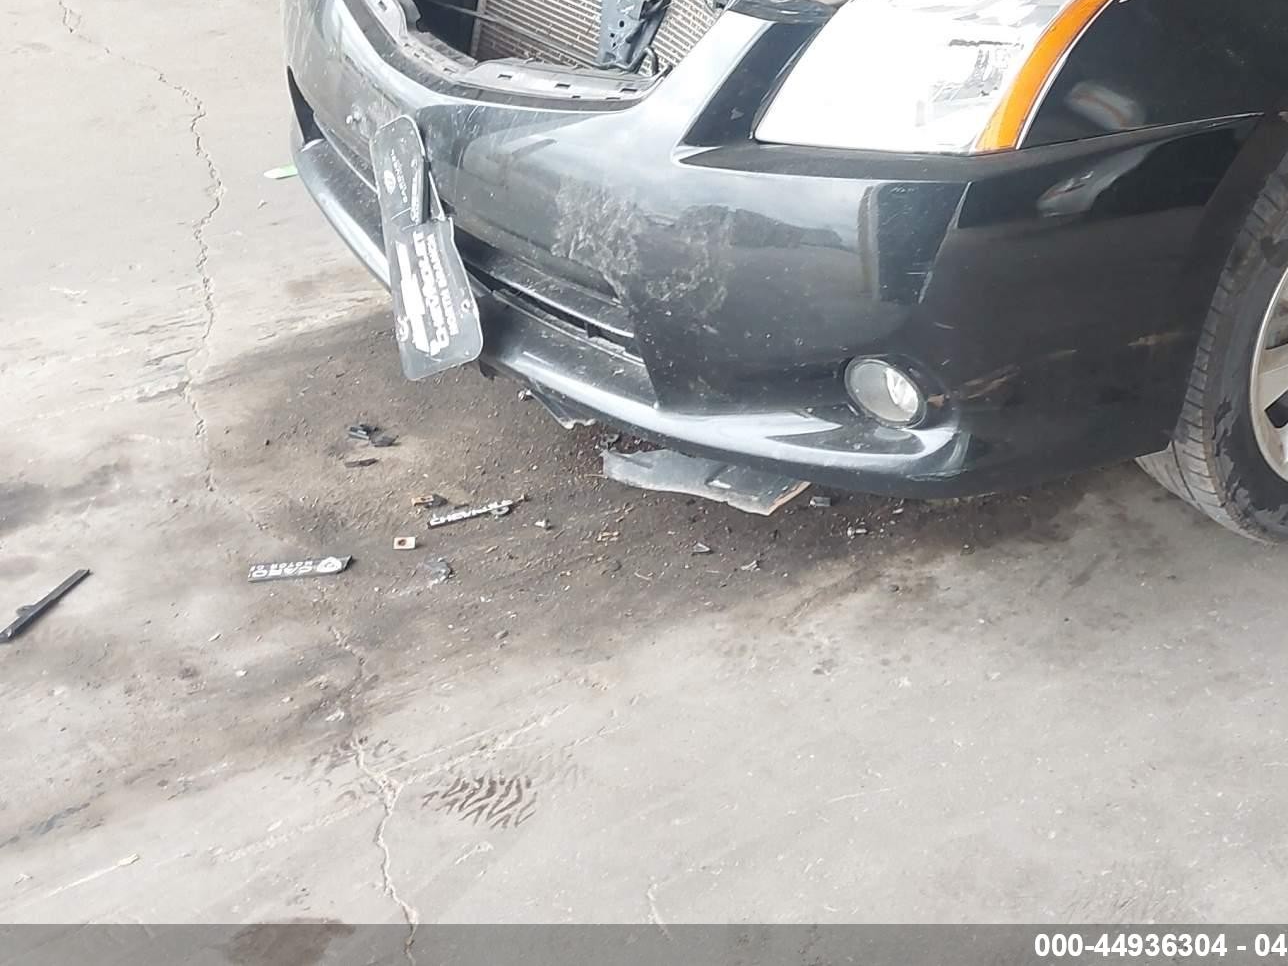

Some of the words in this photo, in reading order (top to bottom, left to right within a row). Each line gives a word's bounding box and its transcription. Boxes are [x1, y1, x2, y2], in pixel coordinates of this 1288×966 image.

[427, 233, 448, 290] BRANCH
[413, 231, 450, 356] CHEVROLET
[440, 288, 459, 336] NORTH
